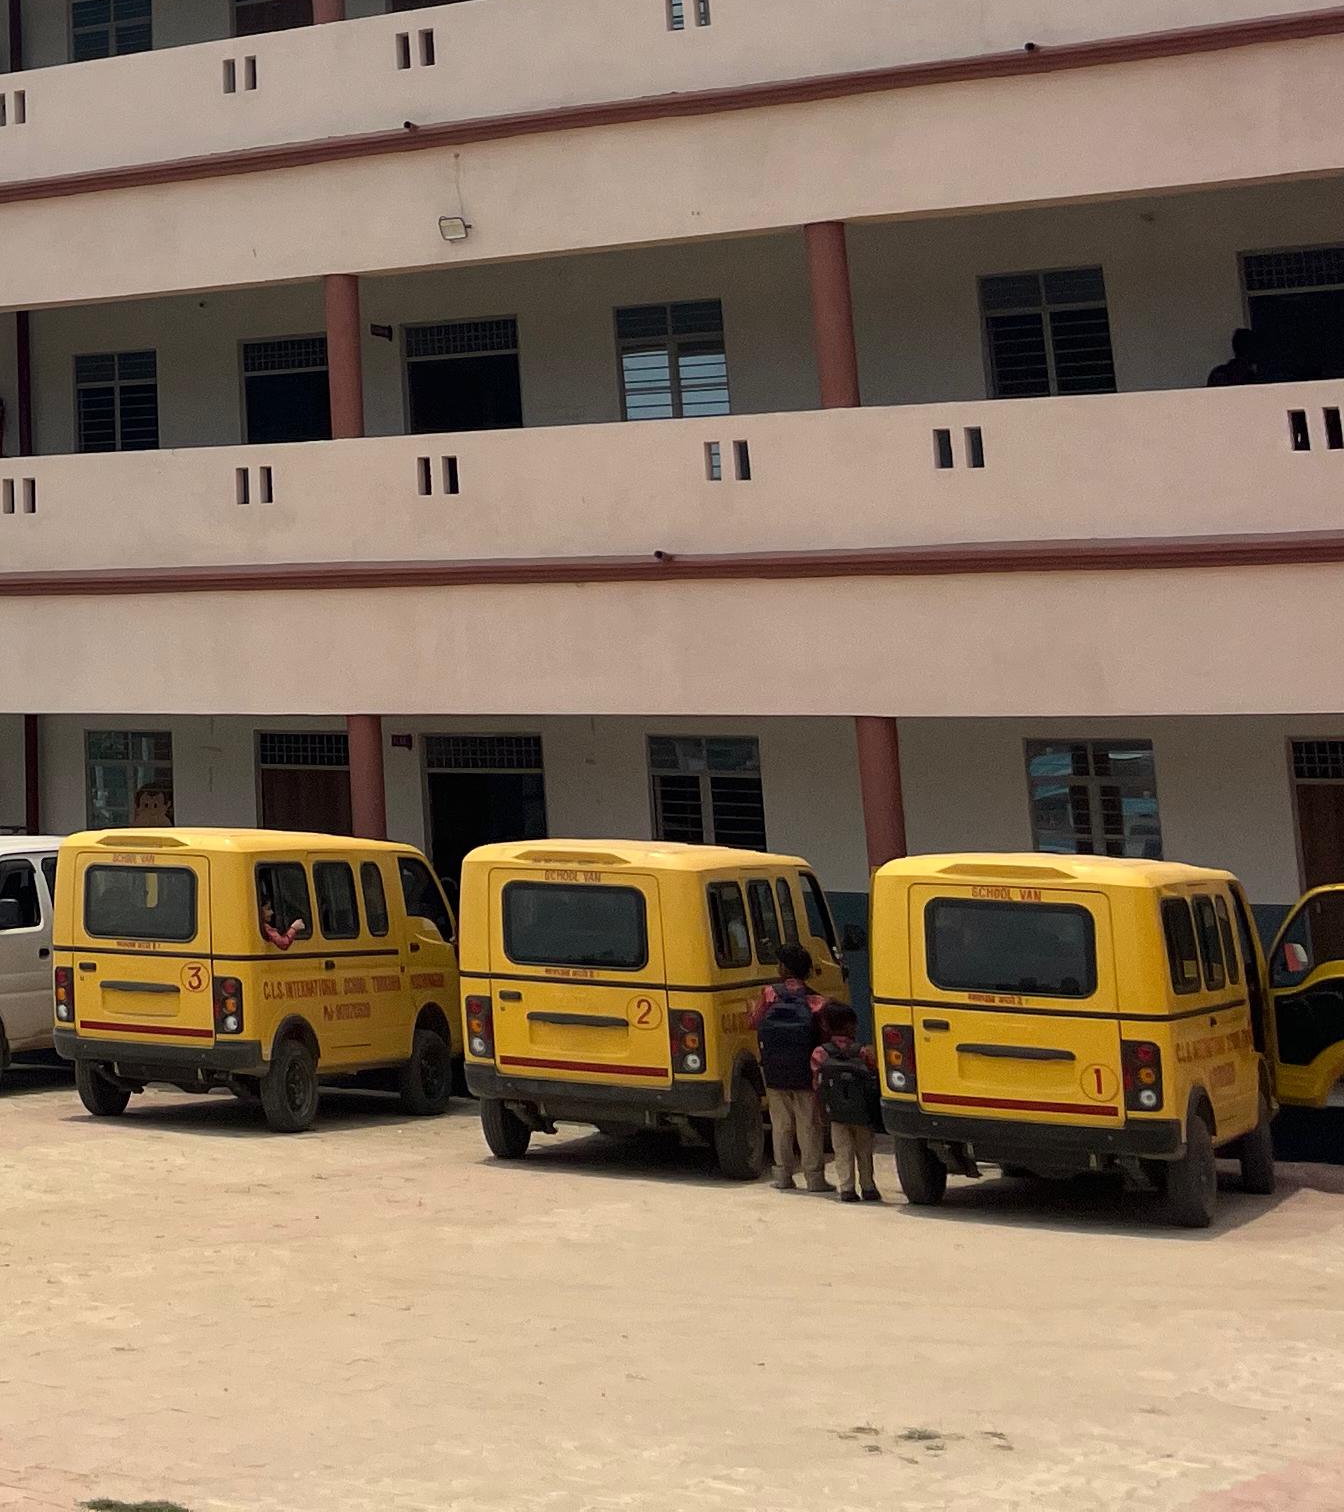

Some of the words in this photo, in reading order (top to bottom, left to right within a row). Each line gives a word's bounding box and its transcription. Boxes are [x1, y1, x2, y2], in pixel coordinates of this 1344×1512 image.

[583, 871, 601, 883] VAN
[971, 886, 1012, 901] SCHOOL
[1019, 889, 1042, 902] VAN
[187, 966, 202, 990] 3
[636, 998, 652, 1025] 2
[1094, 1068, 1103, 1095] 1
